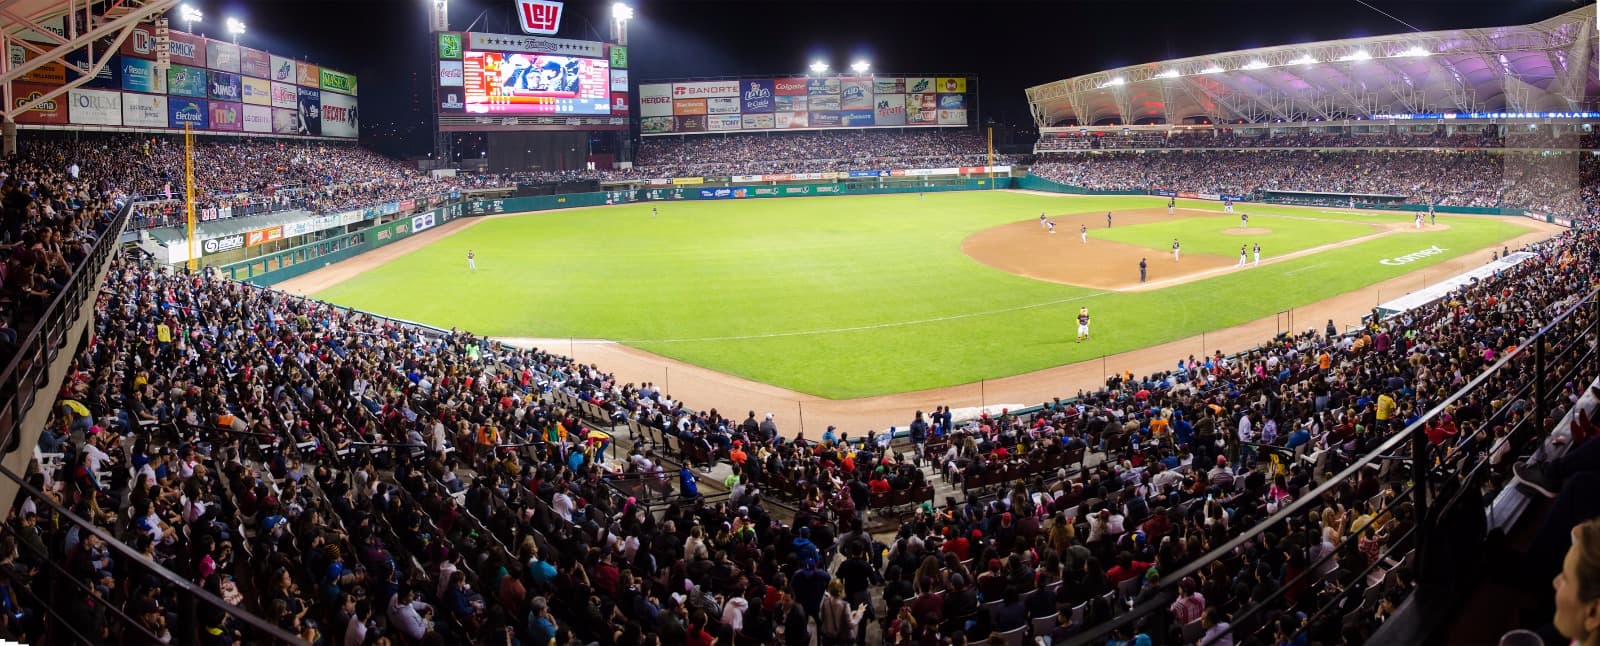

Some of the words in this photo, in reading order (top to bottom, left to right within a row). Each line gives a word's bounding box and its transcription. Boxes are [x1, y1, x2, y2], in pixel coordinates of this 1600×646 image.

[213, 83, 236, 97] JUMEX
[688, 86, 739, 94] BANORTE
[776, 83, 805, 91] Colgate
[72, 93, 119, 109] FORUM
[641, 96, 671, 104] HERDEZ
[323, 104, 347, 123] TECATE
[1379, 245, 1449, 266] Comex
